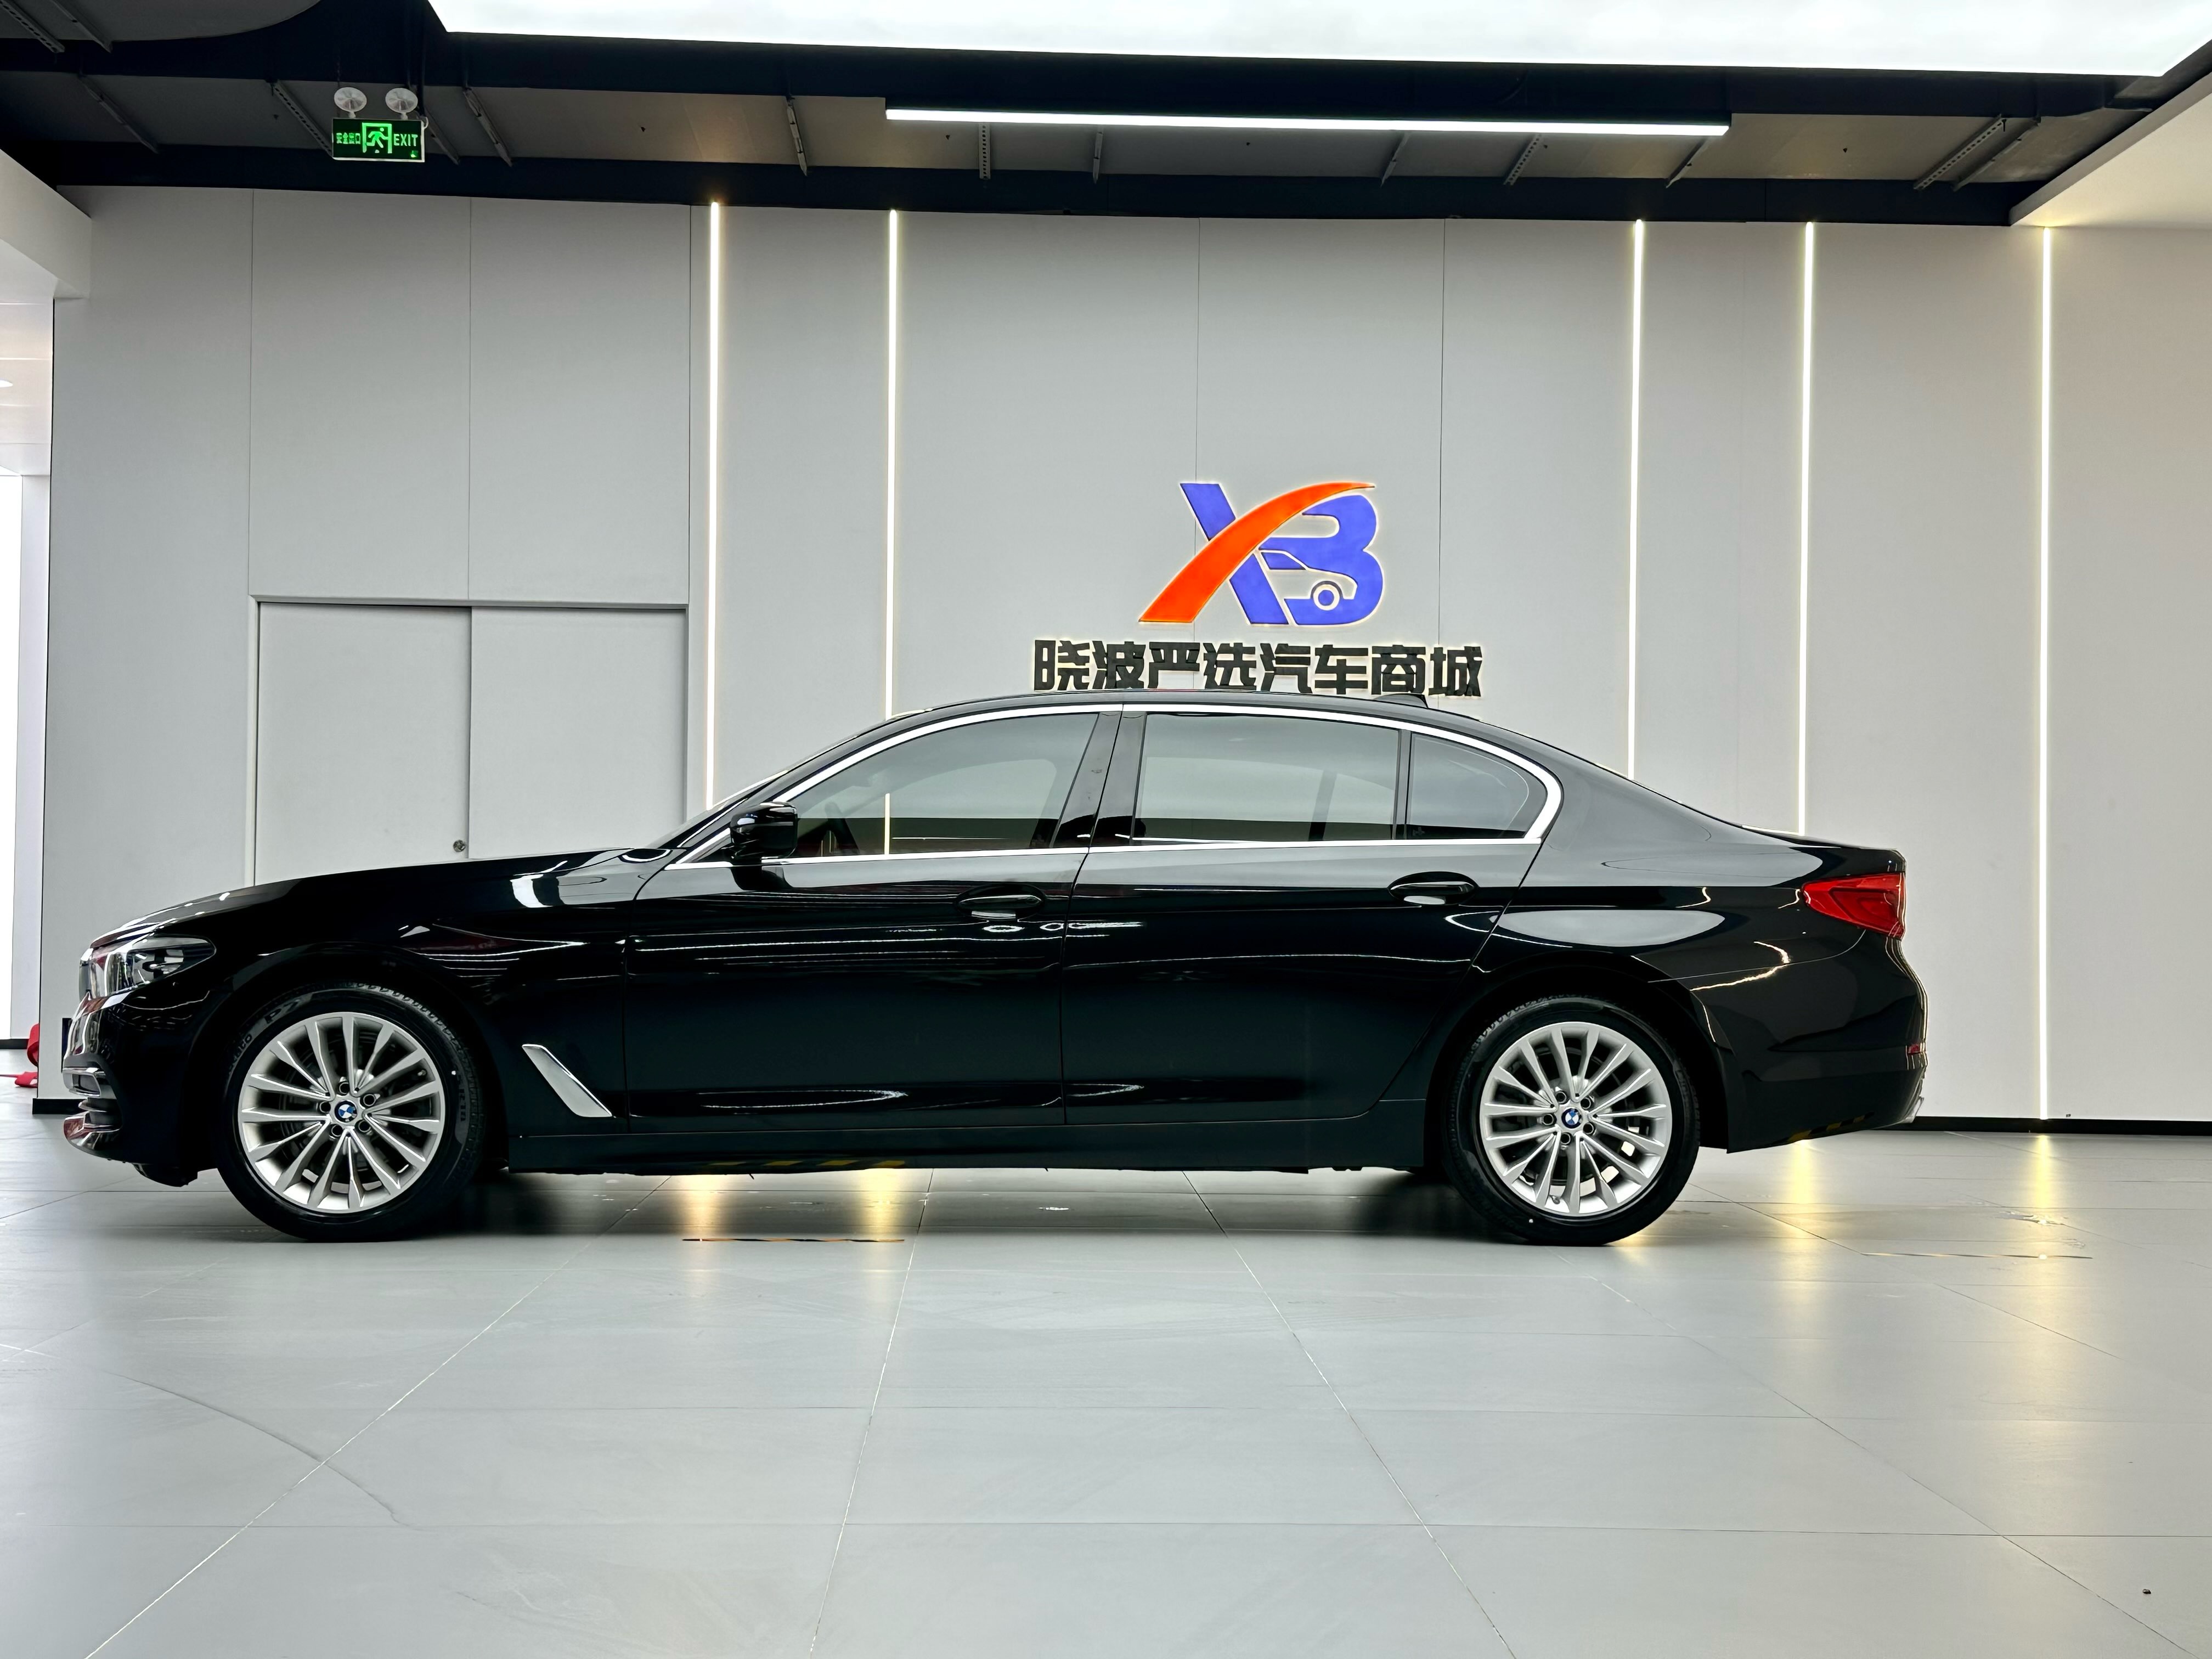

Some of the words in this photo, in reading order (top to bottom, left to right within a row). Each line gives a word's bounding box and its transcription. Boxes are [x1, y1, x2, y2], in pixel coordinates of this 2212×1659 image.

[394, 134, 418, 146] EXIT
[1034, 639, 1482, 697] 晓波严选汽车商城
